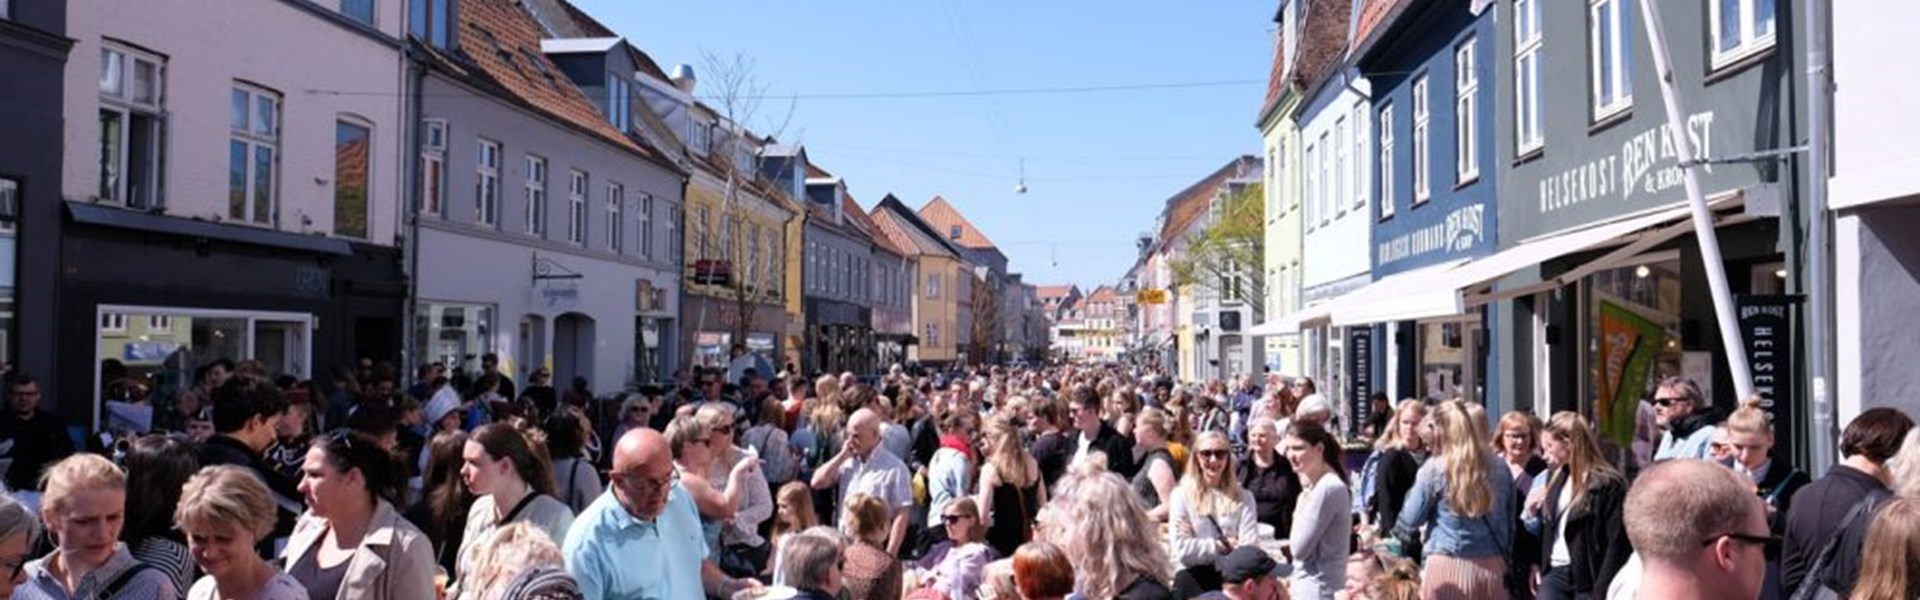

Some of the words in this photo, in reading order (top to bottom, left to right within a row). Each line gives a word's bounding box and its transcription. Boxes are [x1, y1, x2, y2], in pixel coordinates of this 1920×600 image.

[1540, 156, 1616, 213] HELSEKOST
[1622, 128, 1656, 200] REN
[1644, 173, 1657, 194] &
[1741, 305, 1759, 319] REN
[1754, 327, 1775, 431] HELSEKO
